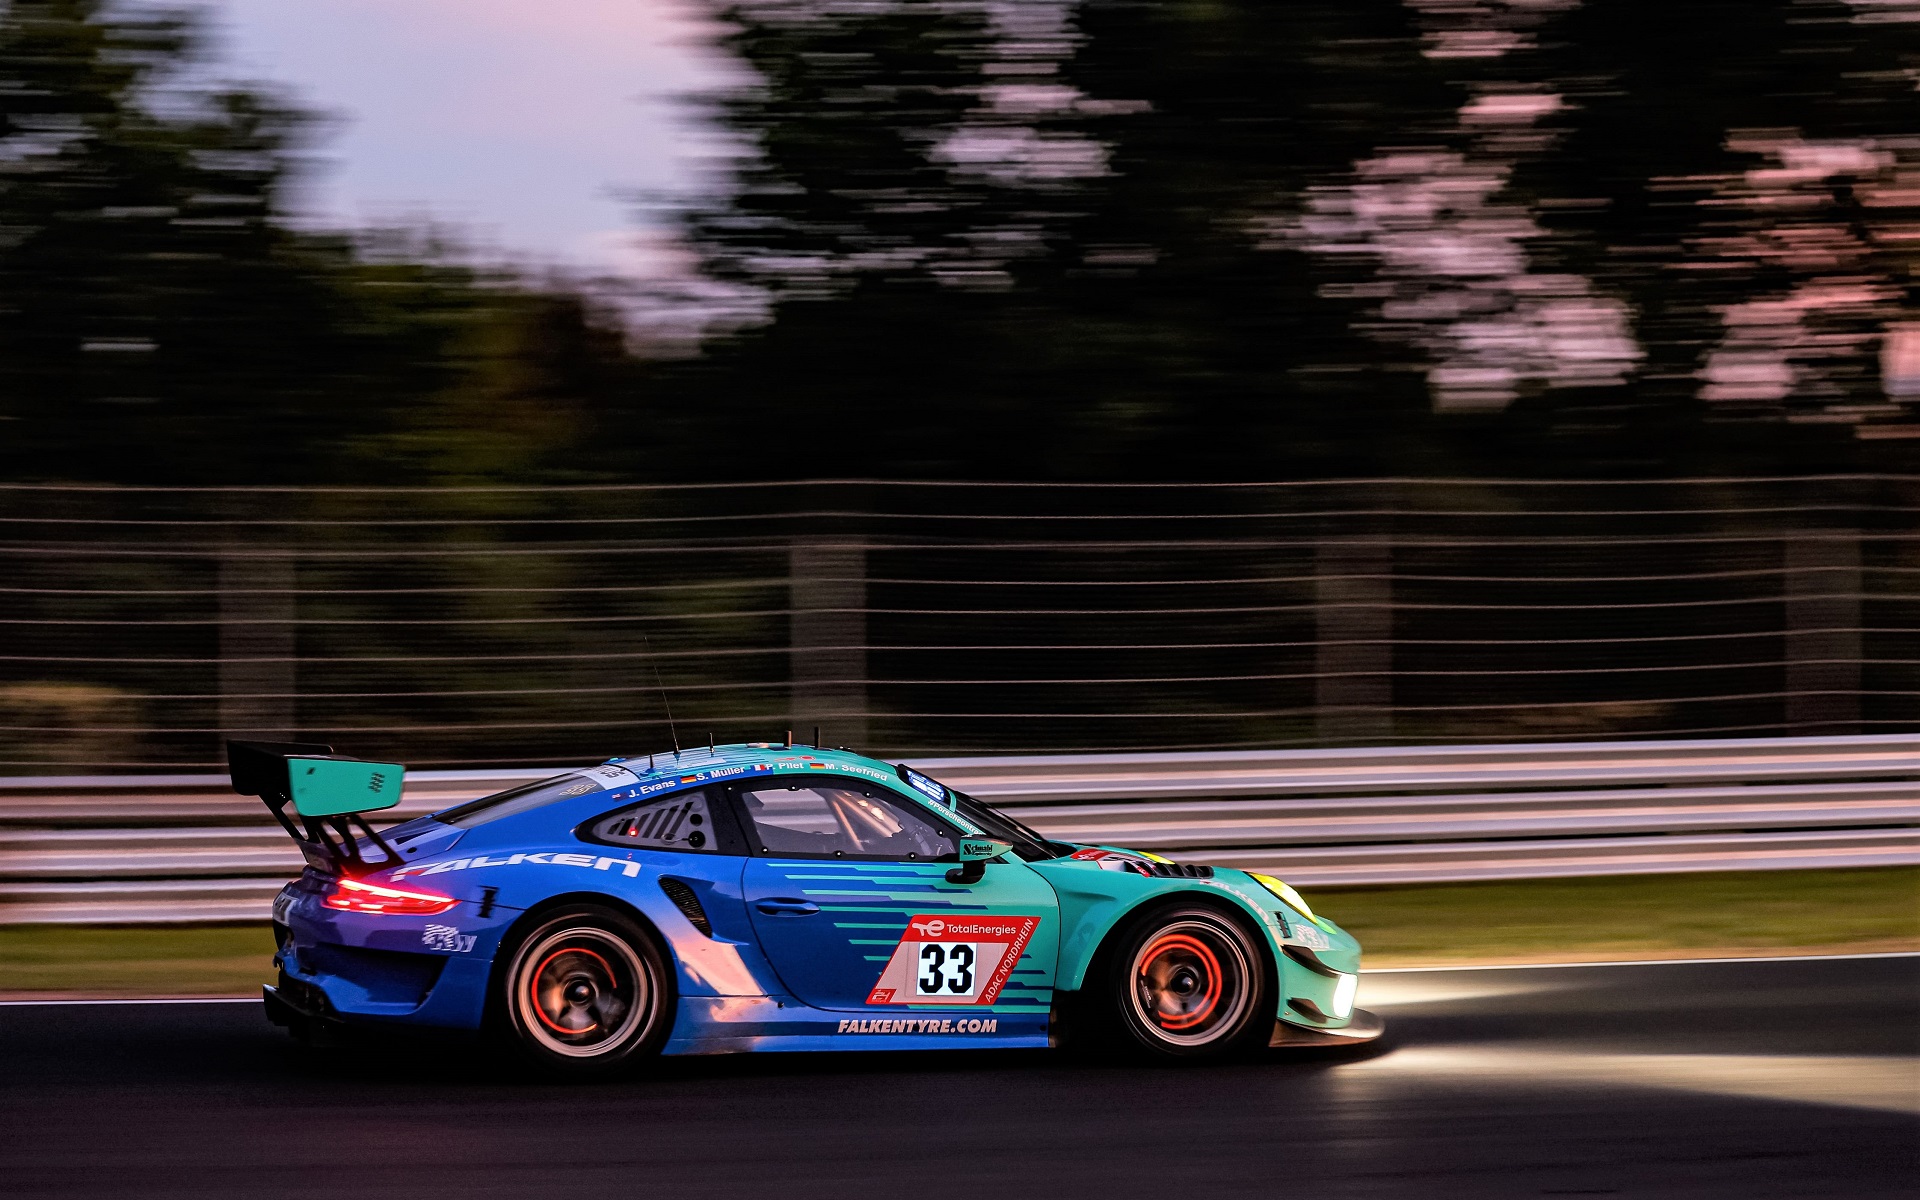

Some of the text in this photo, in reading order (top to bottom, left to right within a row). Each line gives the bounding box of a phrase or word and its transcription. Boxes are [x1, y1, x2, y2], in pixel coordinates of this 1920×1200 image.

[697, 766, 745, 781] S. Müller
[842, 765, 888, 781] Seefried
[629, 780, 676, 799] J. Evans
[388, 853, 642, 882] FALKEN
[947, 925, 1016, 936] TotalEnergies
[919, 944, 974, 994] 33
[985, 919, 1034, 1003] ADAC NORDRHEIN
[838, 1019, 997, 1034] FALKENTYRE.COM
